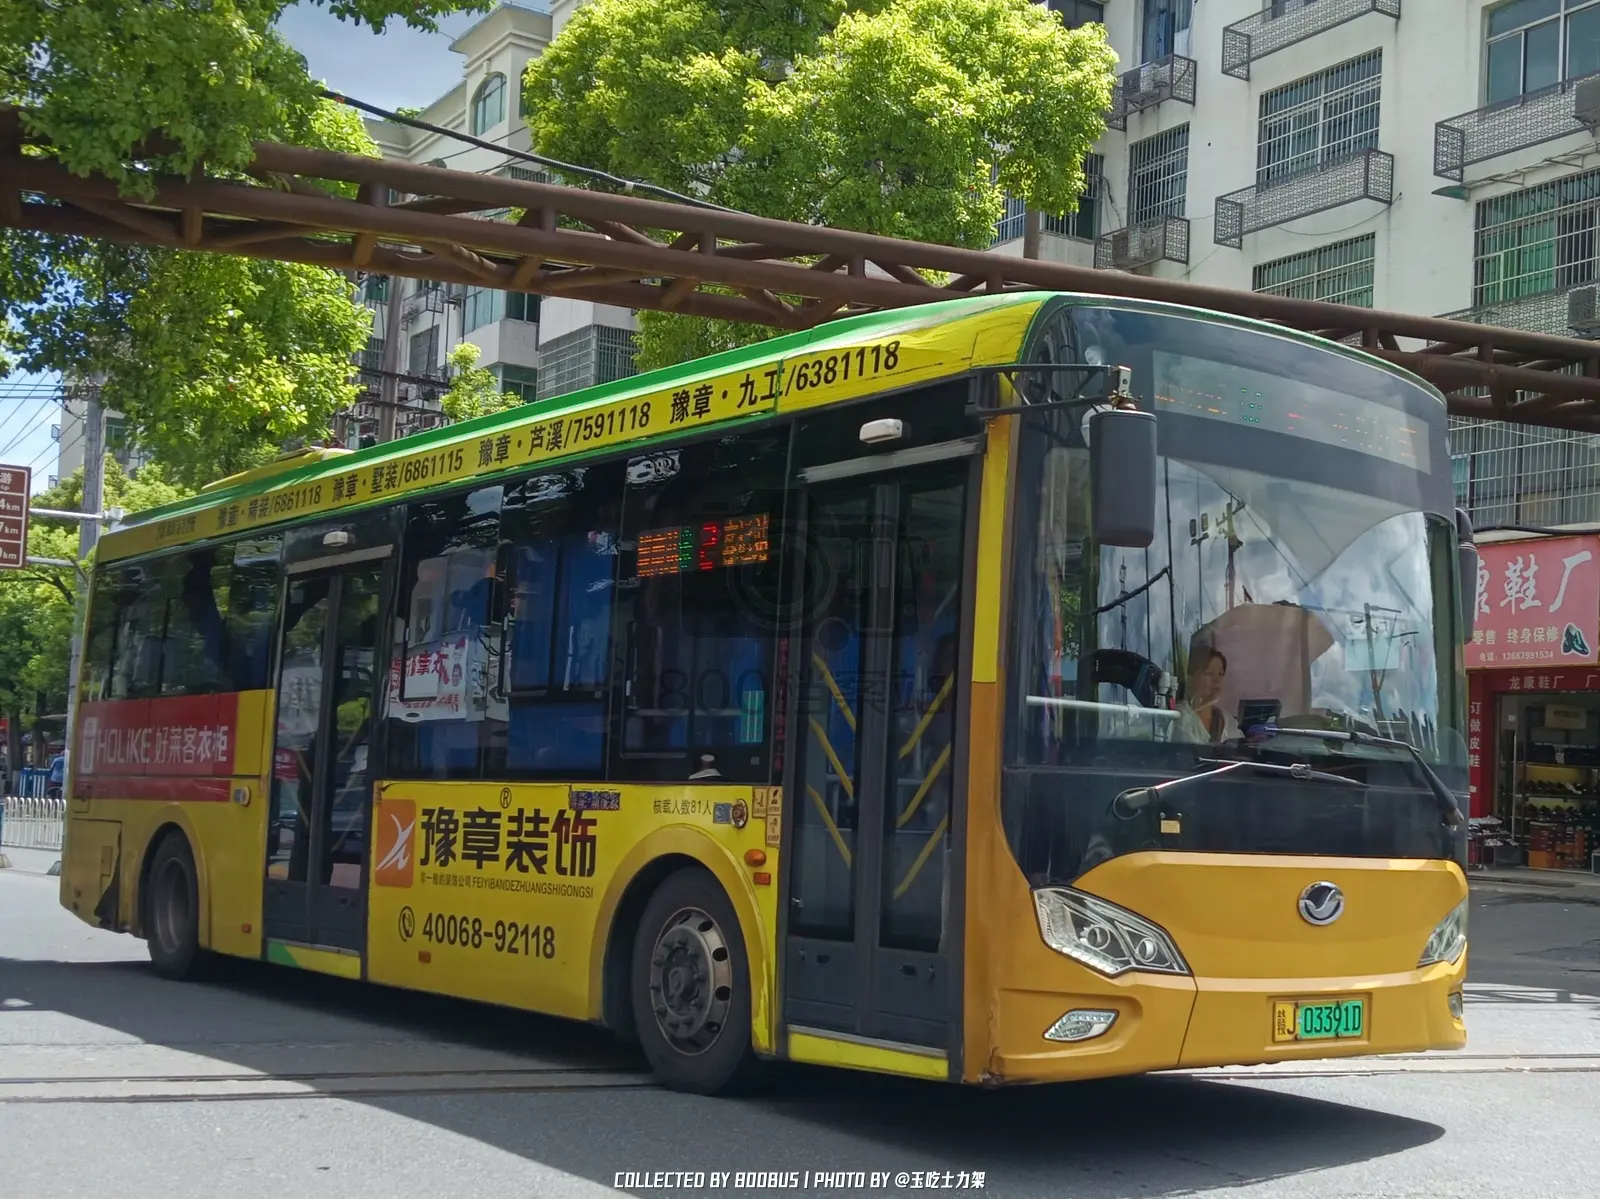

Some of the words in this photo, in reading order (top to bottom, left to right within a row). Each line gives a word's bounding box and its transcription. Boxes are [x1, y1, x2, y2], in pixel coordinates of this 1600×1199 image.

[477, 401, 652, 467] 豫章·芦溪/7591118
[670, 341, 901, 424] 豫章·九工/6381118
[1506, 625, 1559, 644] 终身保修
[1468, 701, 1482, 768] 订做皮鞋
[419, 805, 598, 878] 豫章装饰
[422, 912, 556, 959] 40068-92118
